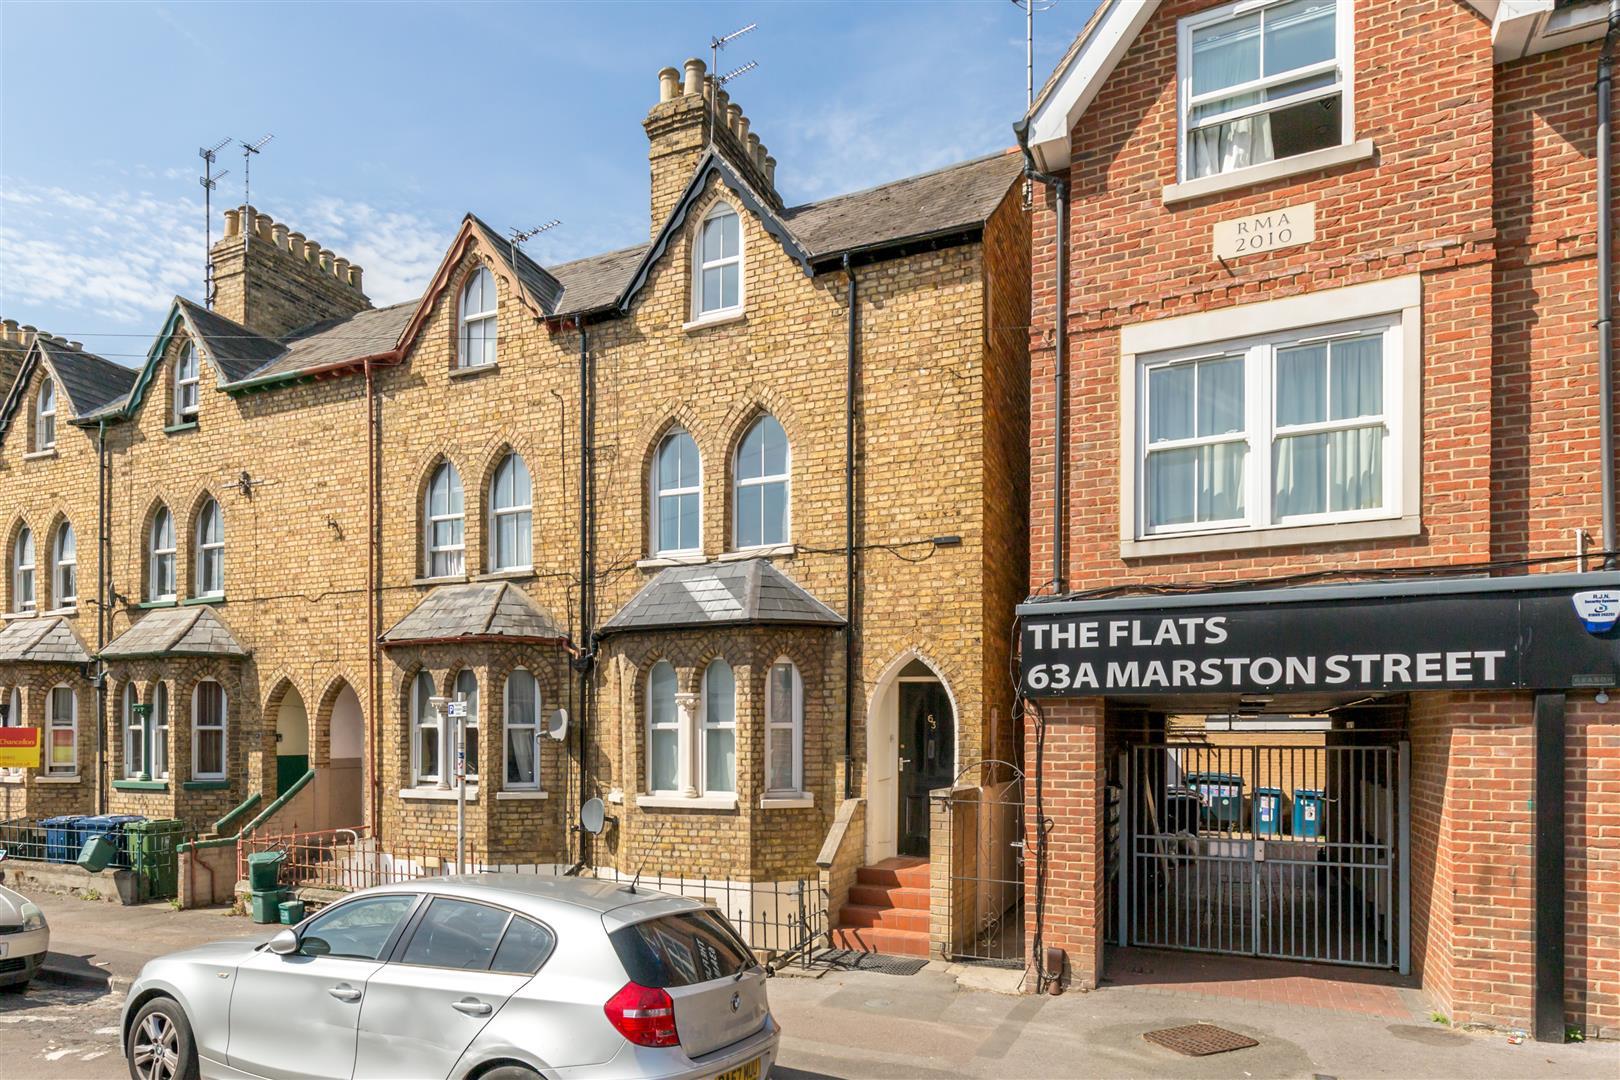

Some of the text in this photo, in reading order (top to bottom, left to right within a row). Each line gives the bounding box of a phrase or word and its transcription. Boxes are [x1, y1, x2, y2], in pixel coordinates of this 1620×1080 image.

[1238, 213, 1290, 235] RMA
[1235, 228, 1292, 252] 2010
[1027, 616, 1228, 650] THE FLATS
[1027, 651, 1506, 690] 63A MARSTON STREET
[928, 714, 937, 730] 63
